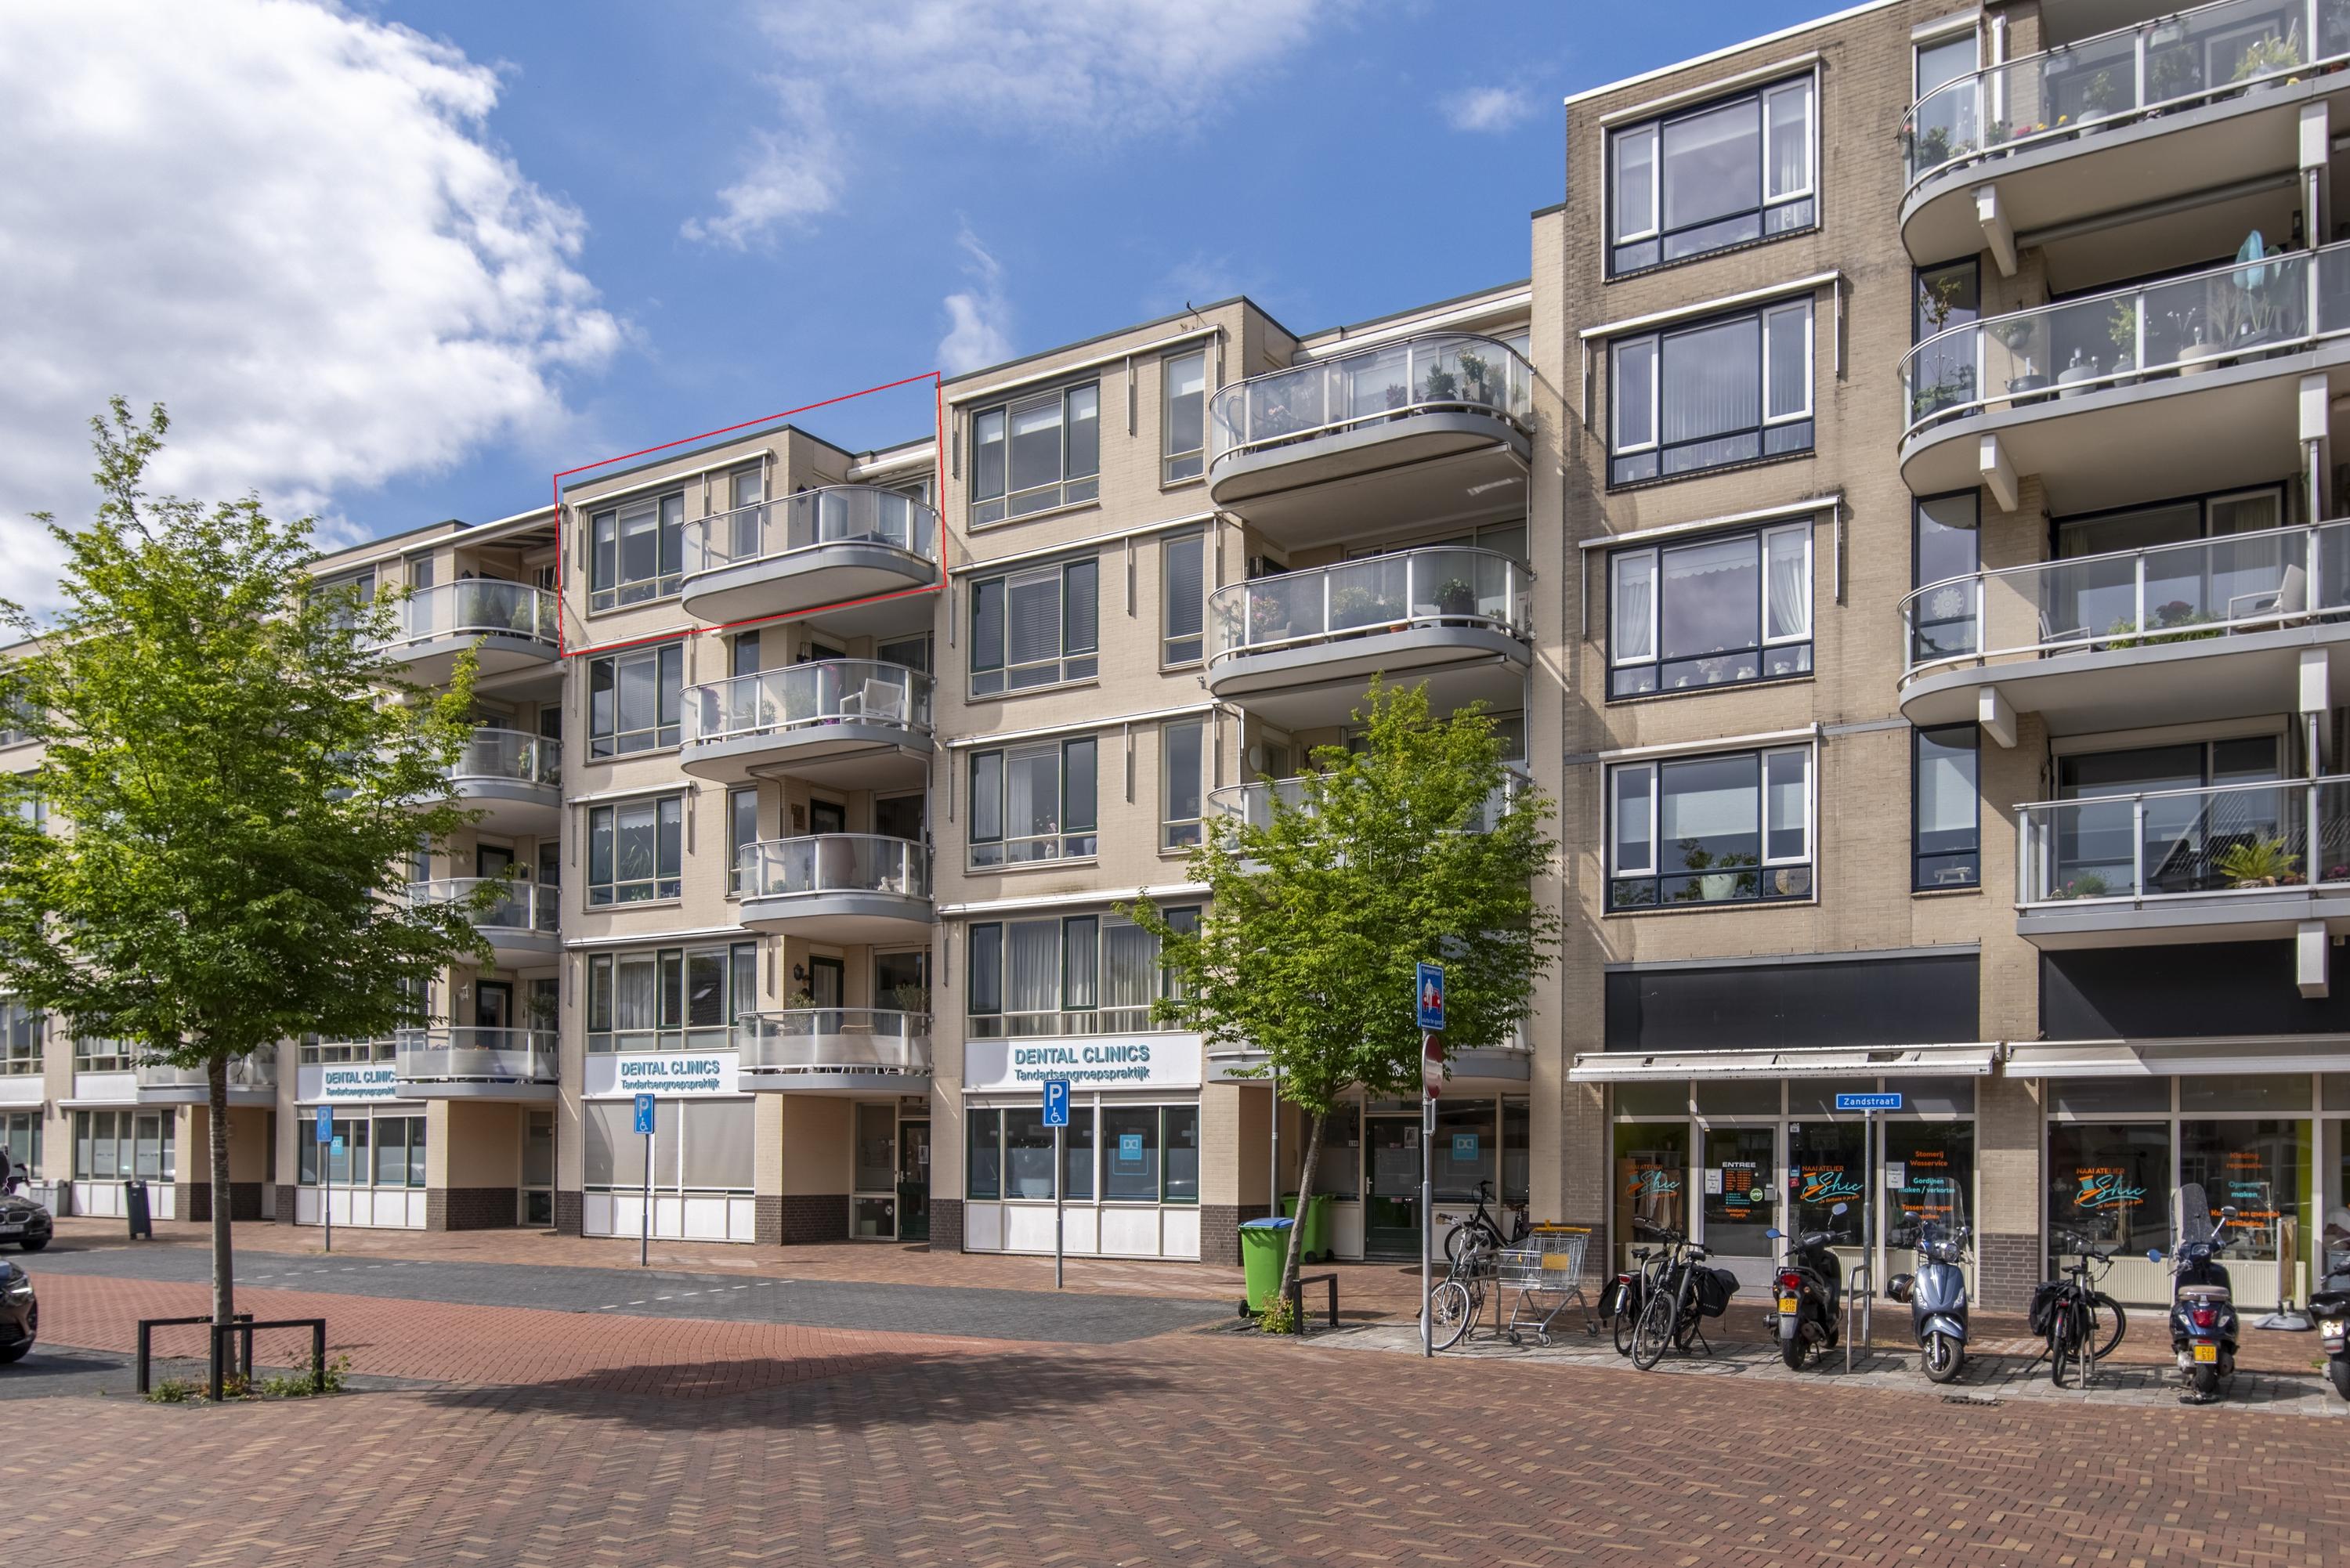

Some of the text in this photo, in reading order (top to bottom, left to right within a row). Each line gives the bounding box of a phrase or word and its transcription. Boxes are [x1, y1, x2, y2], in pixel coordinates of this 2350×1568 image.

[1014, 1045, 1151, 1064] DENTAL CLINICS
[621, 1060, 721, 1075] DENTAL CLINICS
[1014, 1066, 1151, 1082] Tandartsengroepspraktijk
[325, 1071, 395, 1085] DENTAL CLINIC
[621, 1078, 720, 1091] Tandartsengroepspraktijk
[1049, 1084, 1062, 1107] P
[1843, 1097, 1894, 1106] Zandstraat
[638, 1097, 649, 1117] P
[1640, 1170, 1680, 1192] Shic
[1819, 1172, 1864, 1194] Shic
[2095, 1174, 2147, 1199] Shic
